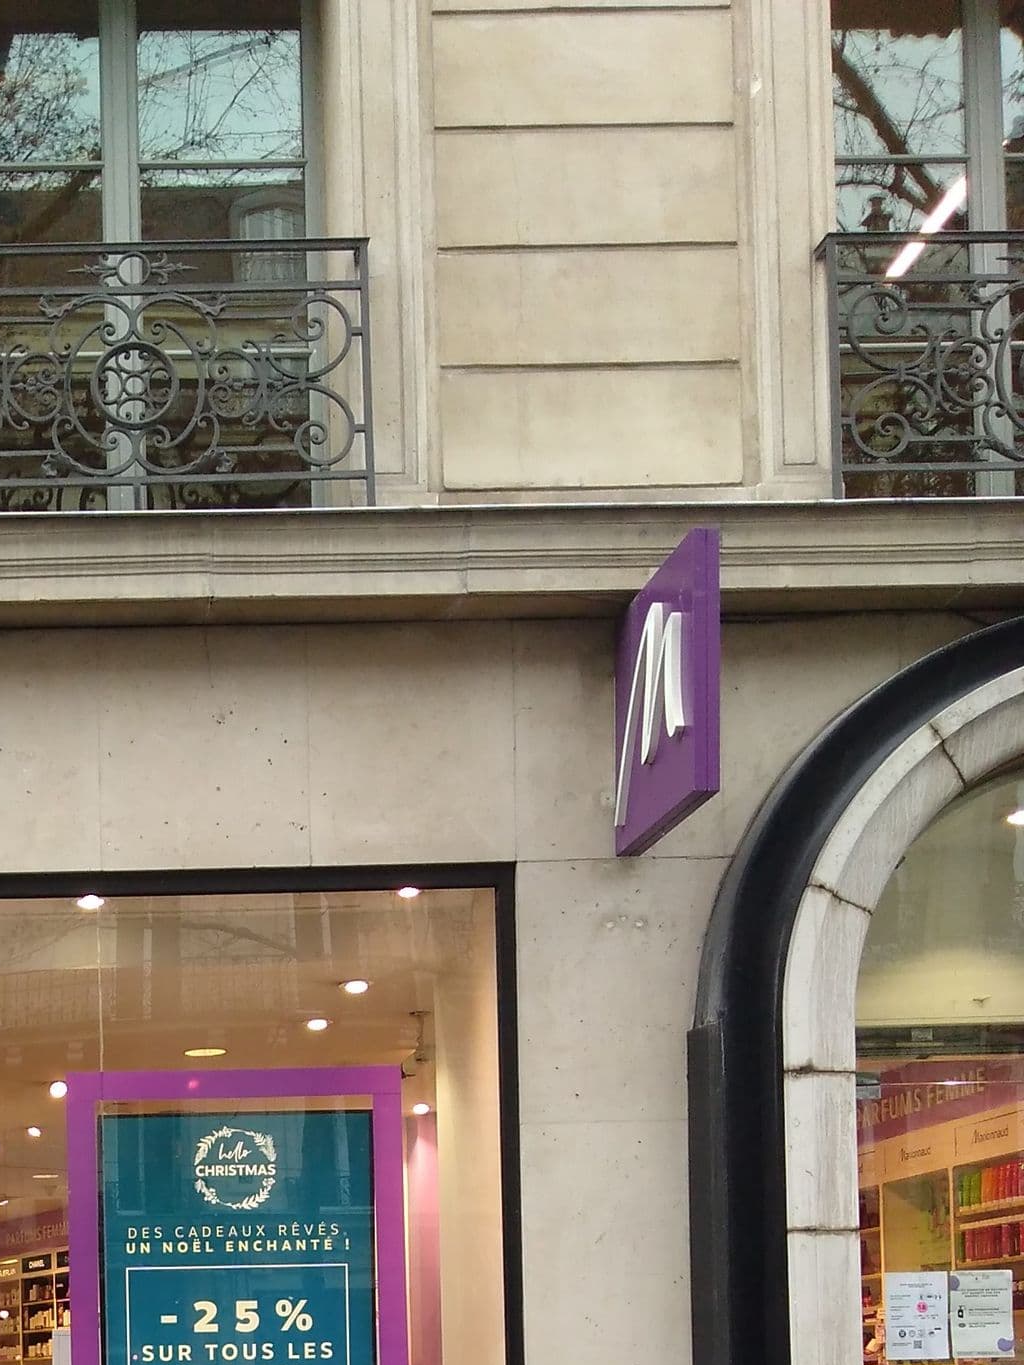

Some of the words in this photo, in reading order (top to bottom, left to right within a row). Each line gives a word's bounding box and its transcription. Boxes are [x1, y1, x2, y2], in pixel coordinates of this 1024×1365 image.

[218, 1141, 253, 1164] hello
[195, 1163, 277, 1178] CHRISTMAS
[127, 1226, 163, 1240] DES
[175, 1224, 266, 1240] CADEAUX
[126, 1242, 151, 1254] UN
[162, 1239, 215, 1254] NOËL
[225, 1236, 334, 1253] ENCHANTÉ
[141, 1344, 193, 1362] SUR
[204, 1343, 275, 1361] TOUS
[287, 1341, 334, 1360] LES
